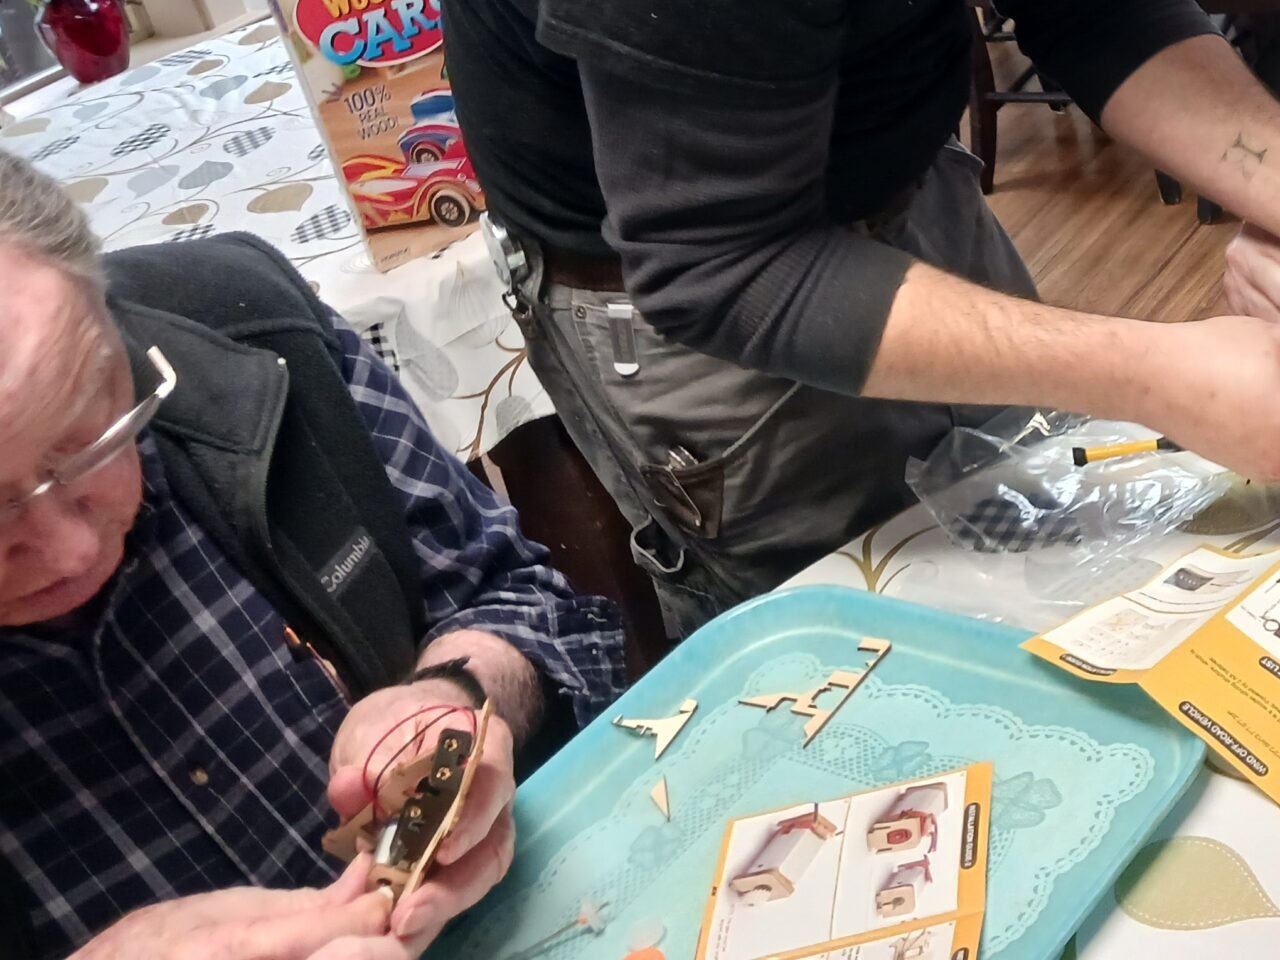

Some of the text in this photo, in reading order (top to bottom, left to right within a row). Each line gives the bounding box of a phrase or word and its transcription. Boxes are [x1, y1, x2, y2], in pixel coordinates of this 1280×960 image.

[344, 85, 392, 114] 100%
[359, 108, 388, 125] REAL
[321, 536, 370, 592] Columbia
[1260, 656, 1279, 672] LIST
[1179, 701, 1213, 729] VEHICLE
[1207, 723, 1250, 757] OFF-ROAD
[1244, 753, 1269, 774] WIND
